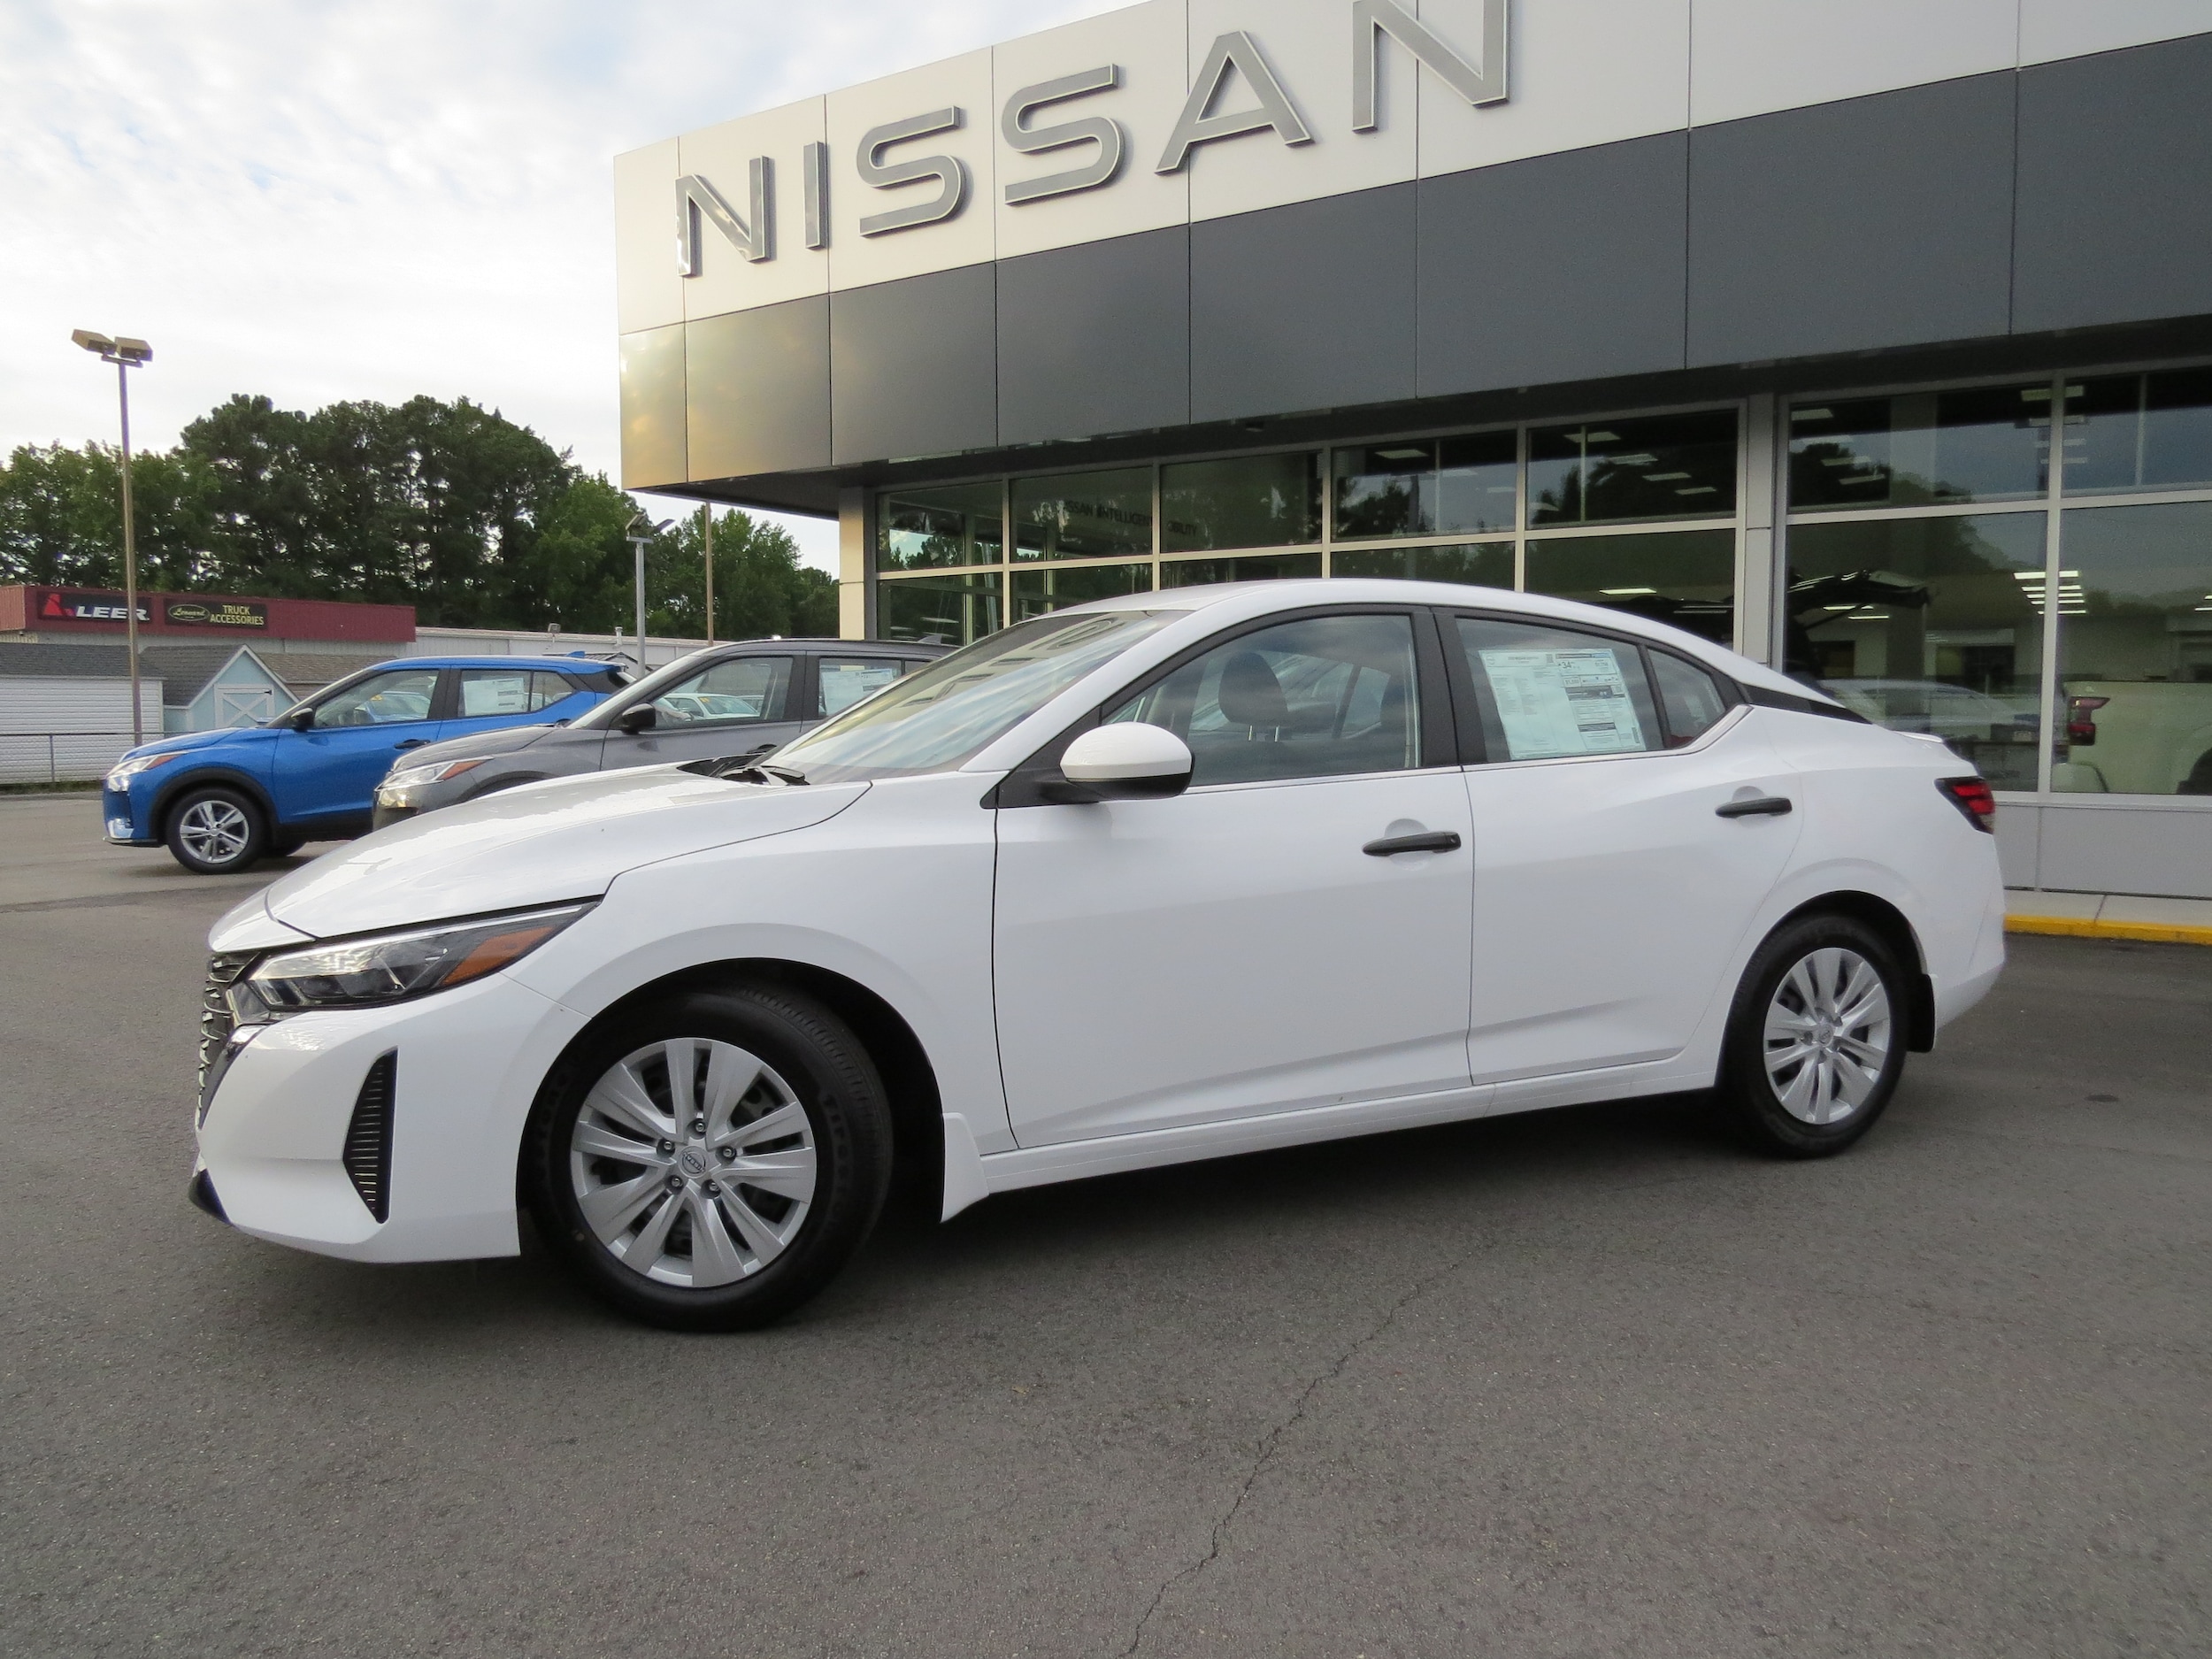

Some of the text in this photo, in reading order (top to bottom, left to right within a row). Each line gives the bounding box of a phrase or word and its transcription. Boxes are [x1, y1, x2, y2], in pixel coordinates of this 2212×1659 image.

[674, 0, 1513, 277] NISSAN
[1096, 503, 1153, 527] INTELLIGEN
[76, 606, 150, 621] LEER
[222, 604, 251, 616] TRUCK
[210, 614, 265, 626] ACCESSORIES
